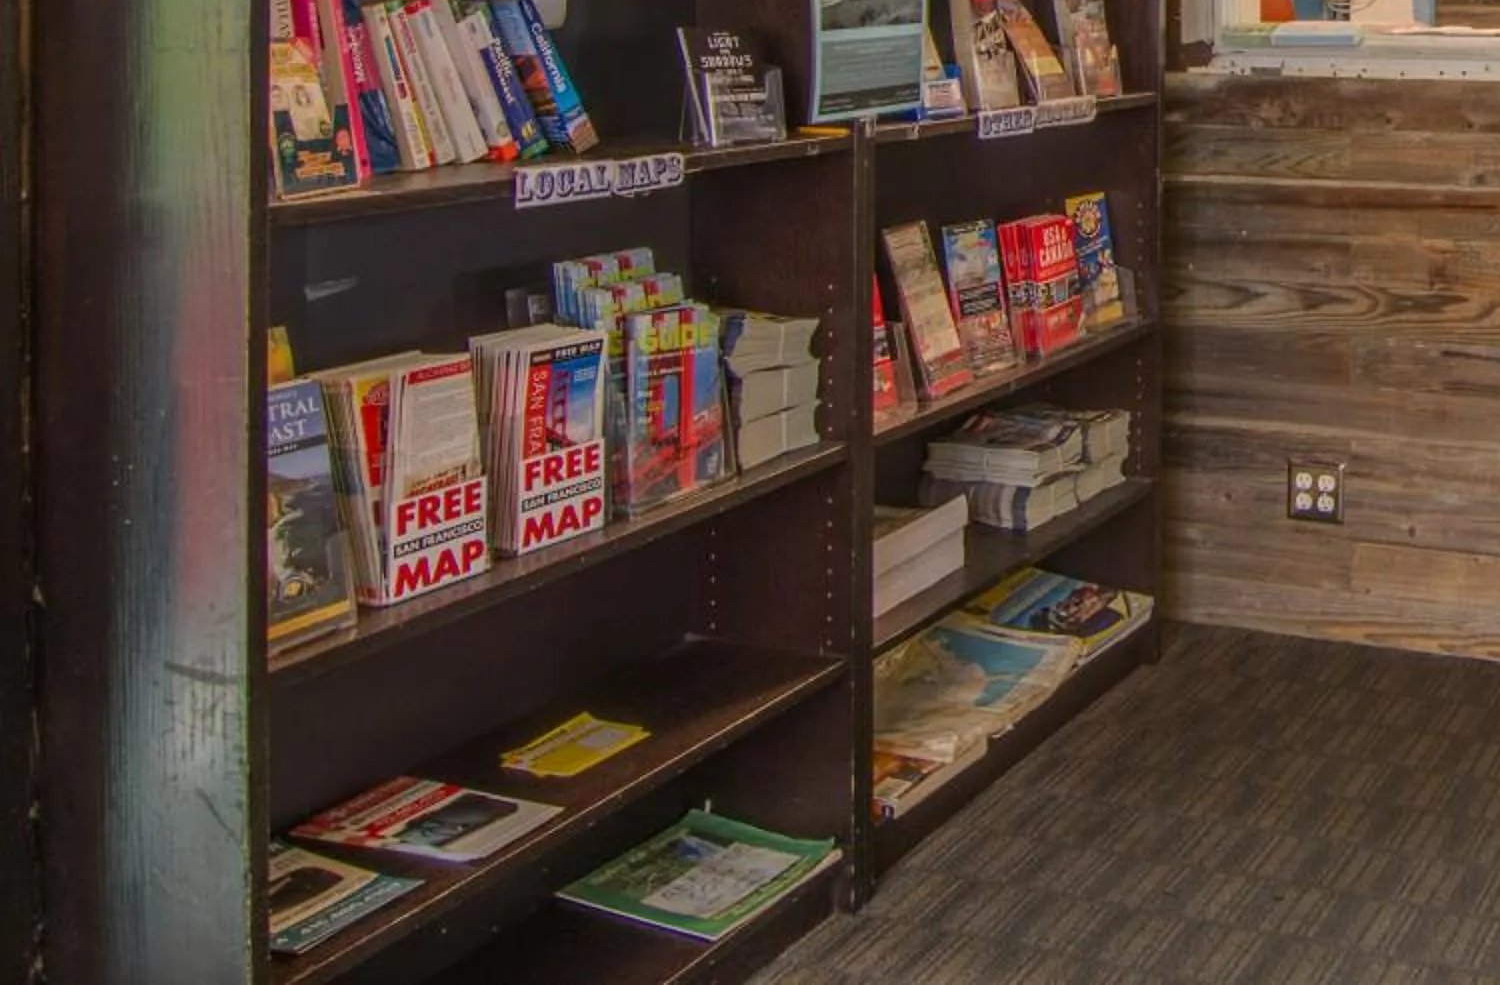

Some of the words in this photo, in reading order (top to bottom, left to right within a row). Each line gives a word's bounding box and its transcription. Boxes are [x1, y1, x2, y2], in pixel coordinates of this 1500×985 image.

[529, 22, 567, 93] California
[517, 166, 611, 203] LOCAL
[617, 155, 682, 192] MAPS
[524, 443, 600, 492] FREE
[396, 481, 483, 537] FREE
[522, 493, 547, 513] SAN
[548, 477, 602, 504] FRANCISCO
[395, 538, 420, 558] SAN
[421, 518, 484, 552] FRANCISCO
[522, 496, 602, 551] MAP
[394, 538, 486, 599] MAP
